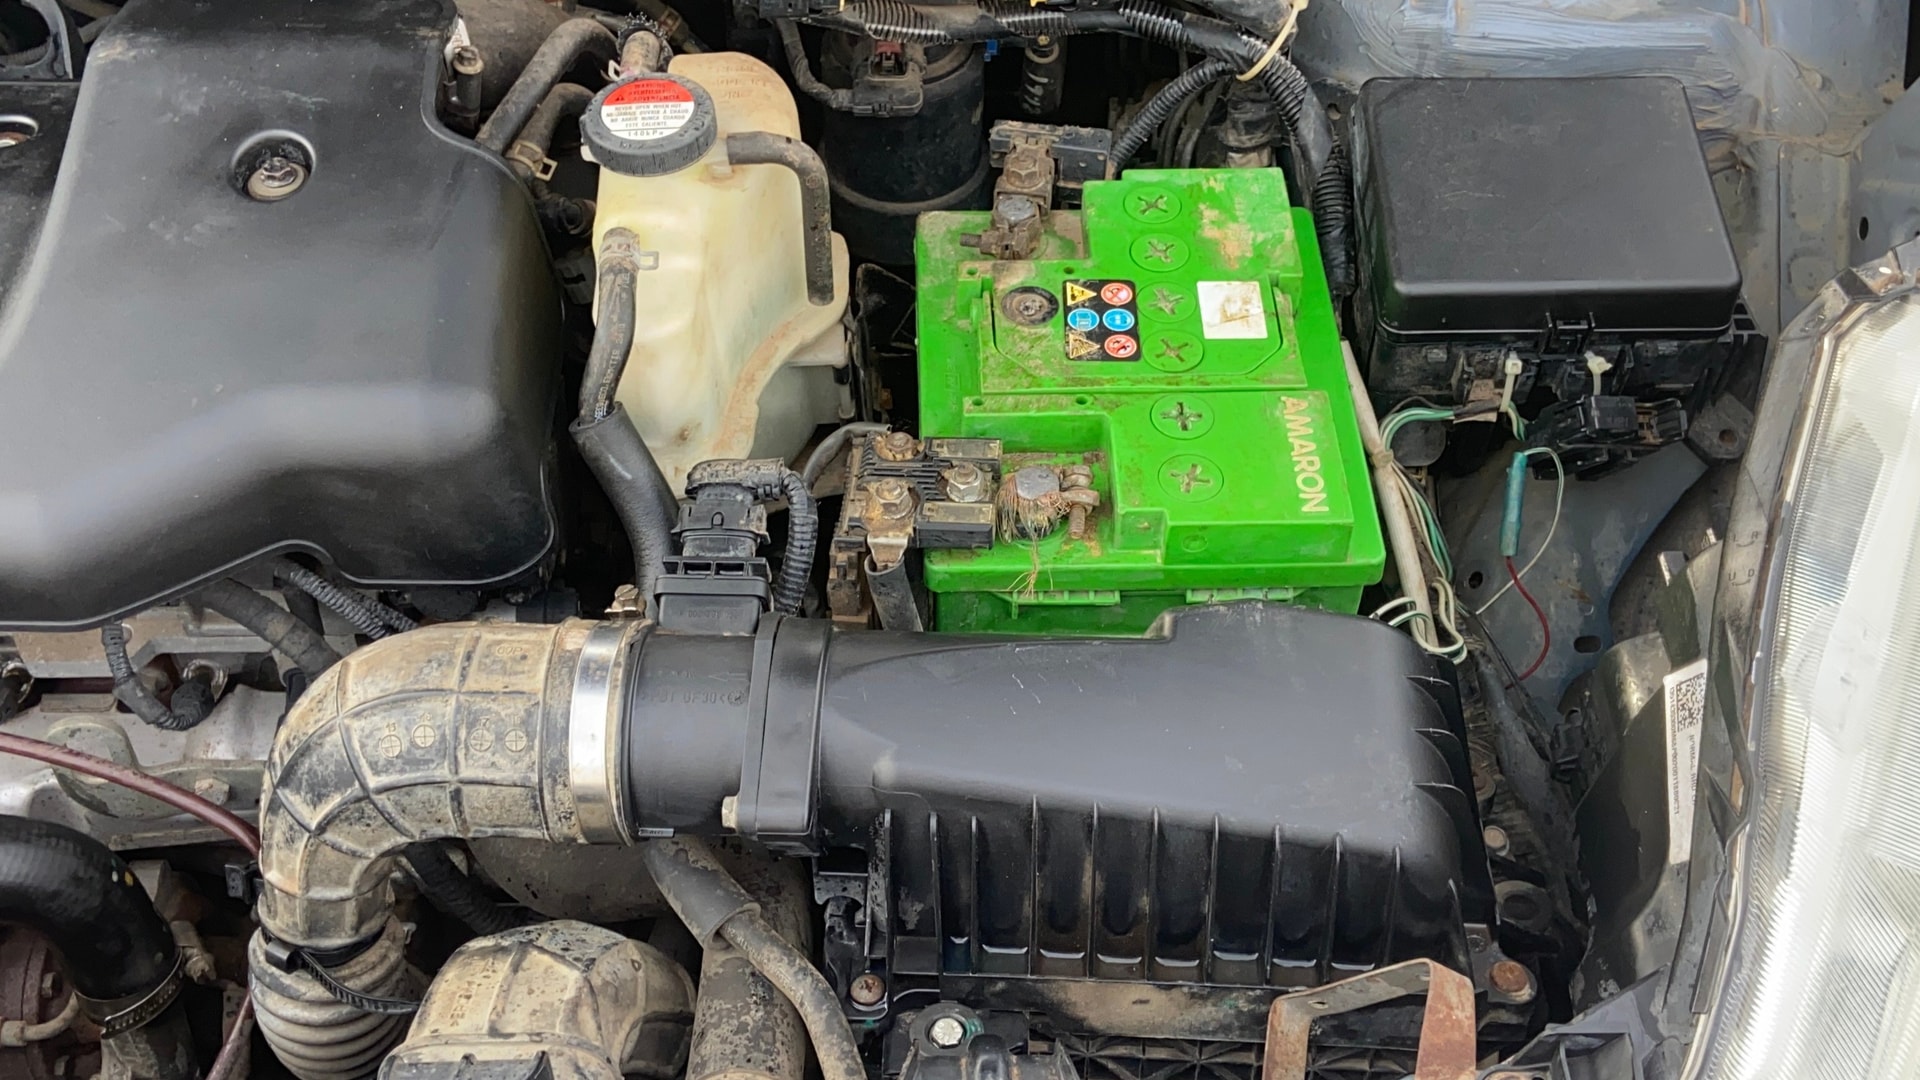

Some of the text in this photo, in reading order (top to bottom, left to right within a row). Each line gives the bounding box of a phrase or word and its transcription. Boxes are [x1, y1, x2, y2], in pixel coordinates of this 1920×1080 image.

[1281, 396, 1329, 512] AMARON
[1751, 530, 1759, 540] R
[1728, 568, 1756, 581] U D
